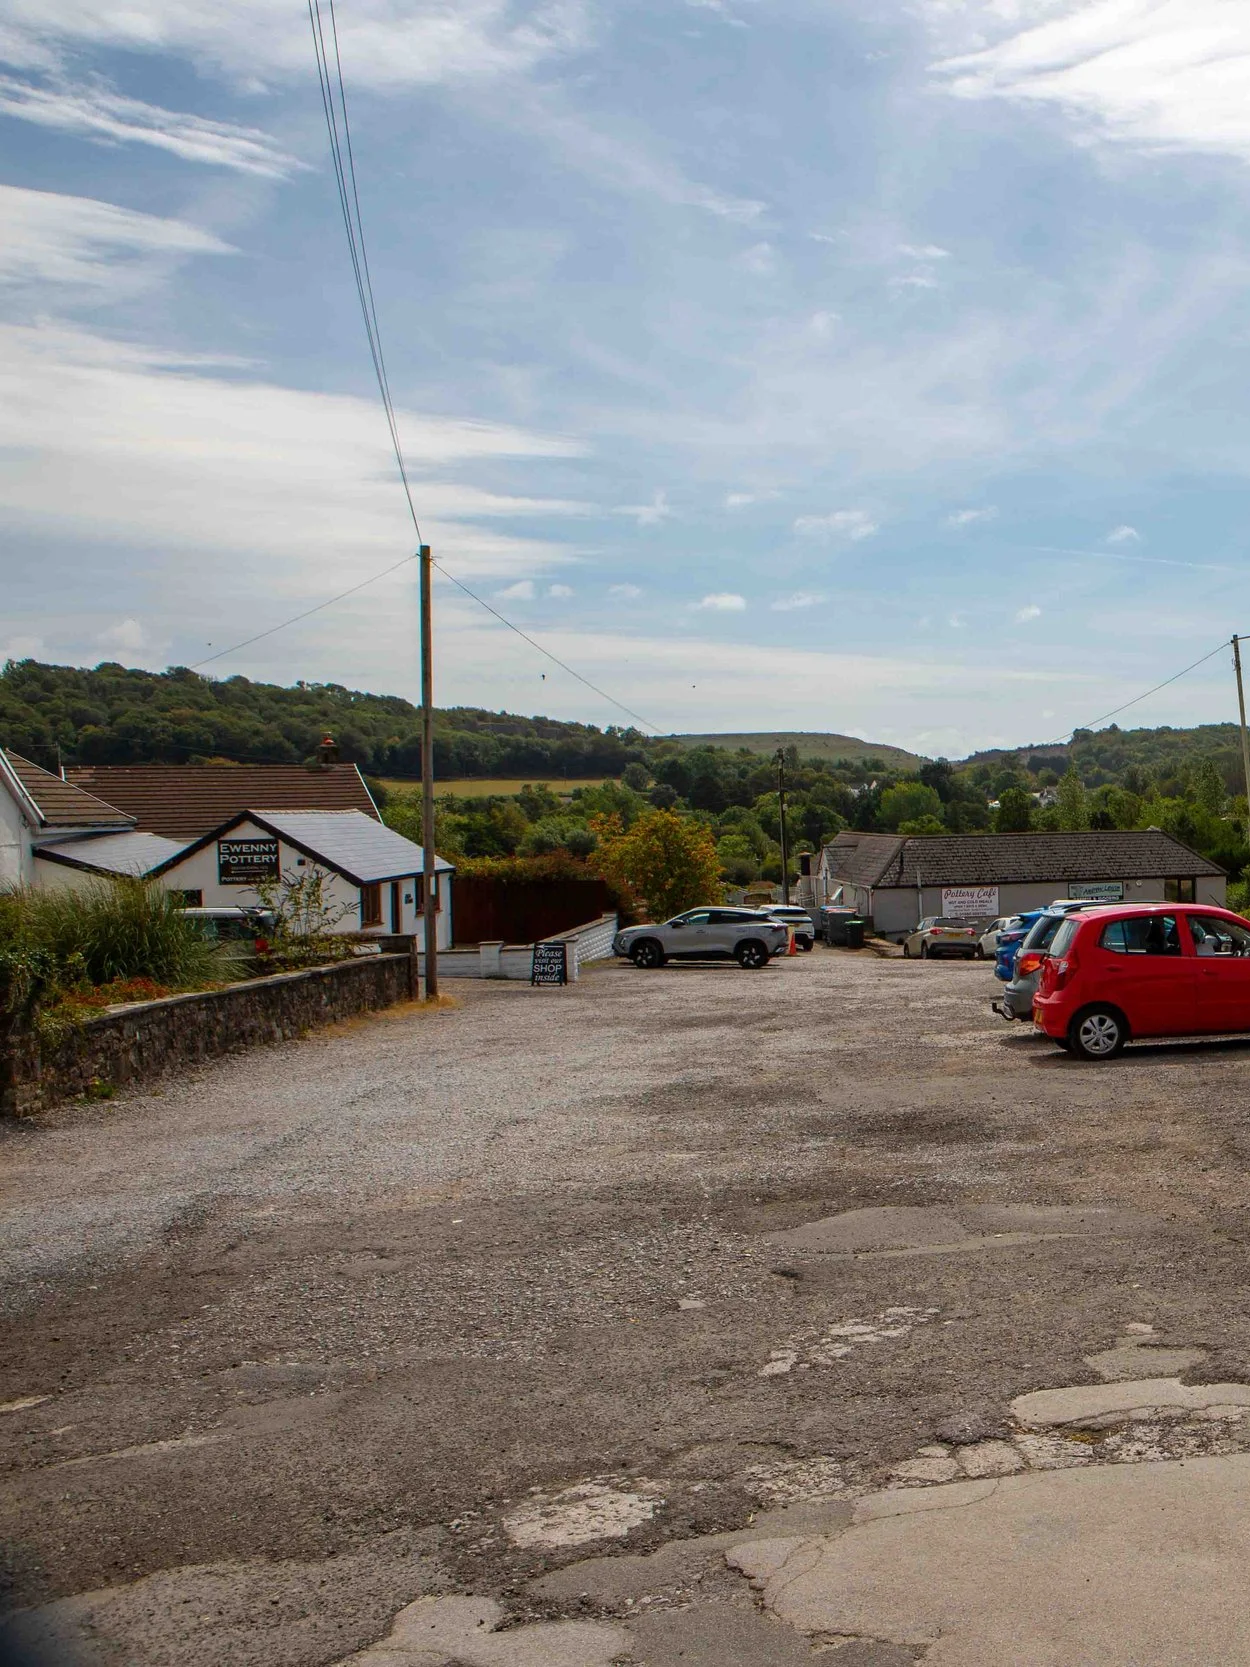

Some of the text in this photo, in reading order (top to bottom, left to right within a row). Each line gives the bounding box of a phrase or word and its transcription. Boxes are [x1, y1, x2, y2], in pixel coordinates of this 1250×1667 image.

[220, 843, 278, 853] EWENNY
[220, 854, 278, 864] POTTERY
[944, 887, 997, 899] Pottery Café
[535, 948, 563, 957] Please
[533, 964, 562, 974] SHOP
[535, 973, 560, 982] inside
